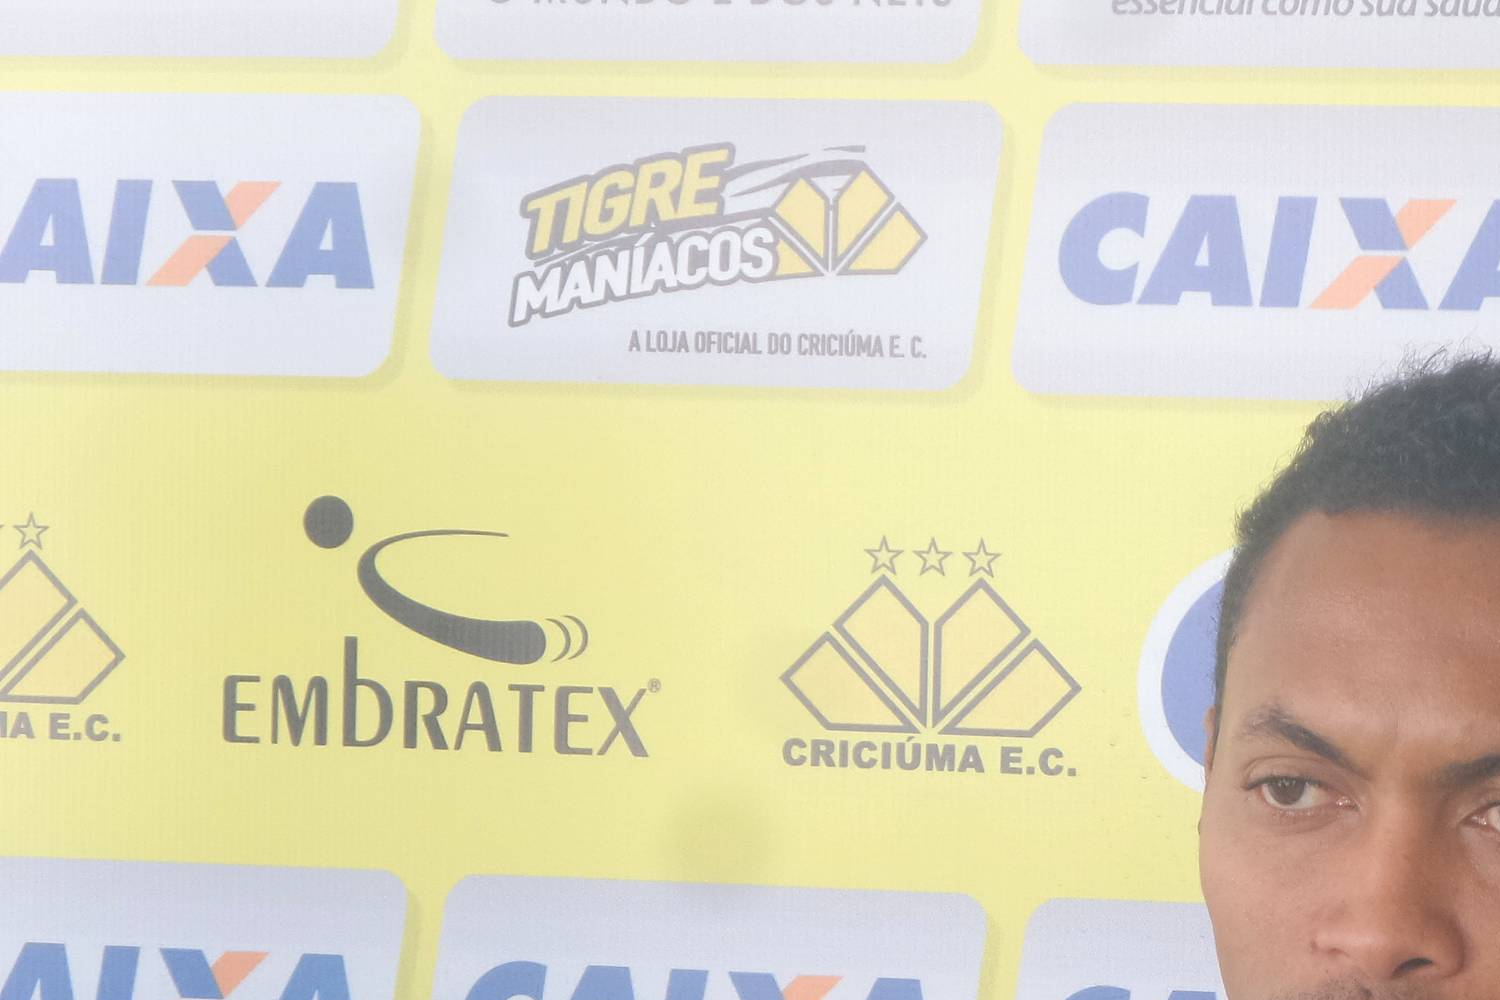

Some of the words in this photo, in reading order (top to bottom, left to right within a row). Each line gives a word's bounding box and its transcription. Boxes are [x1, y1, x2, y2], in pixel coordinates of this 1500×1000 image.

[524, 146, 731, 256] TIGRE
[512, 228, 774, 323] MANÍACOS
[629, 331, 640, 352] A
[646, 332, 689, 353] LOJA
[695, 332, 762, 355] OFICIAL
[768, 335, 791, 355] DO
[798, 329, 883, 358] CRICIÚMA
[49, 713, 121, 742] E.C.
[782, 736, 984, 773] CRICIÚMA
[1000, 747, 1077, 777] E.C.
